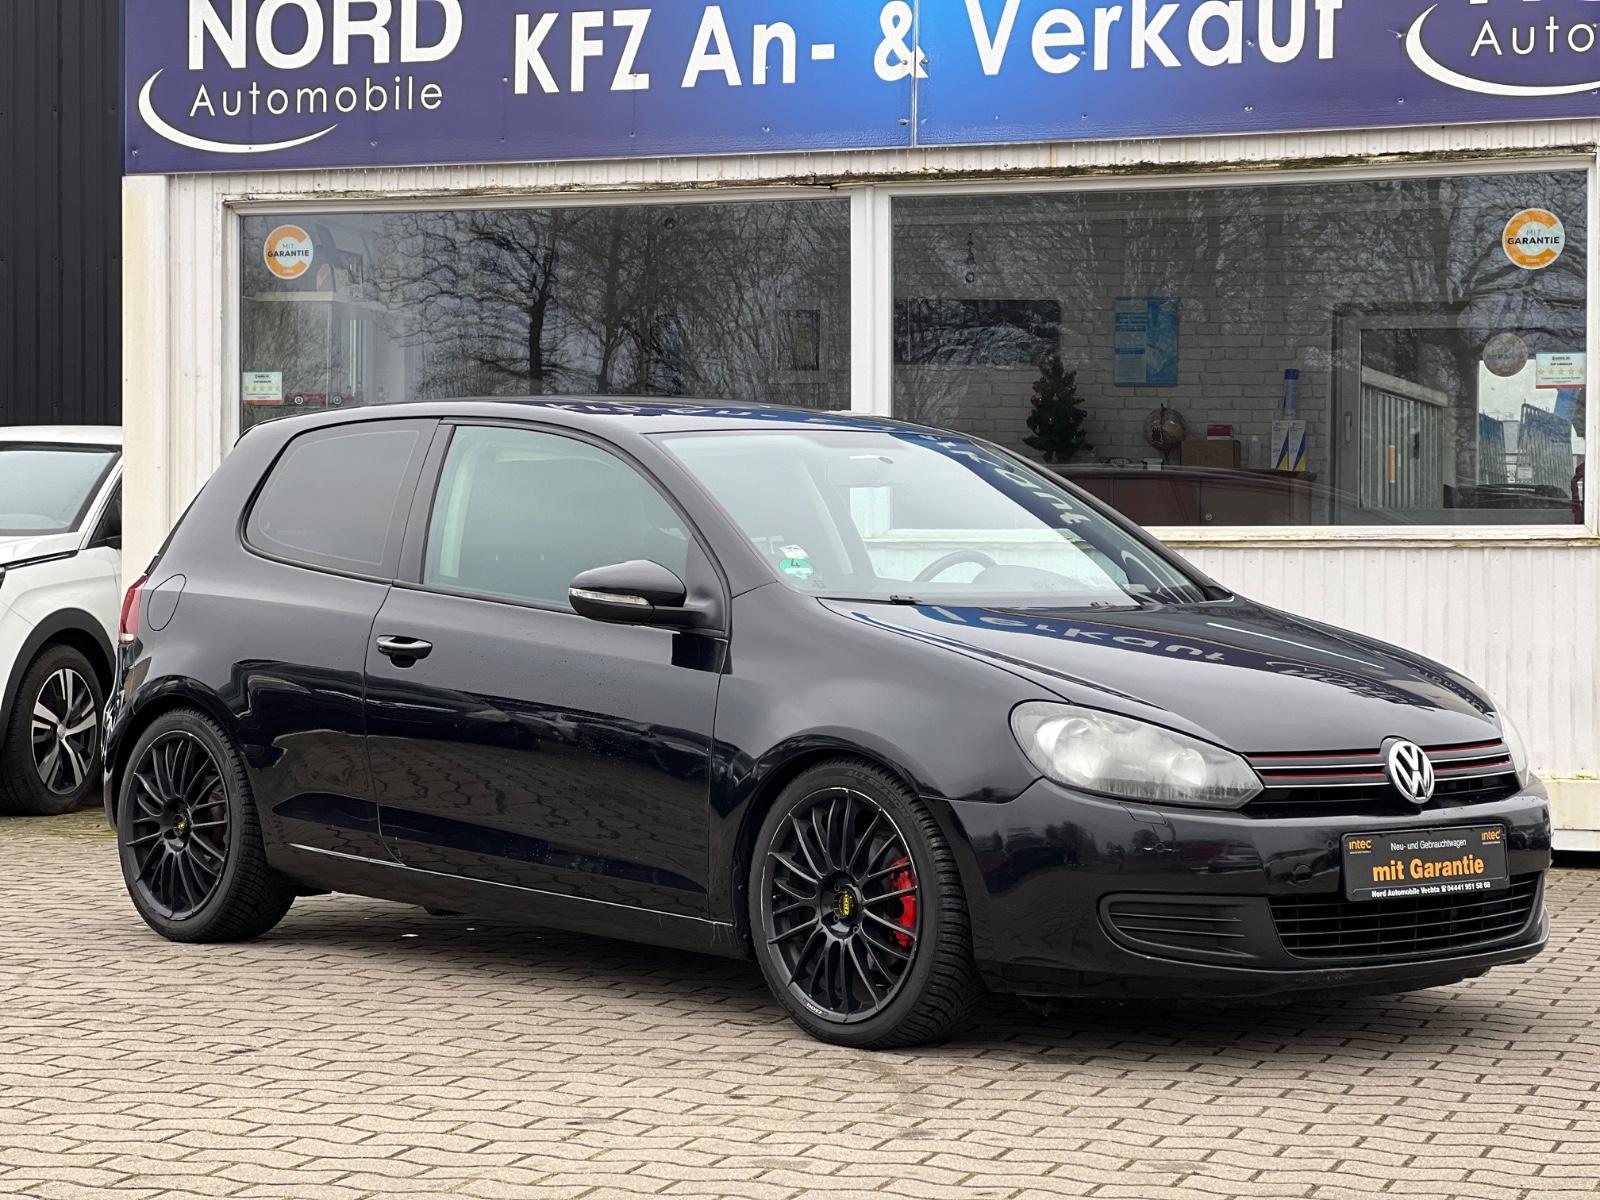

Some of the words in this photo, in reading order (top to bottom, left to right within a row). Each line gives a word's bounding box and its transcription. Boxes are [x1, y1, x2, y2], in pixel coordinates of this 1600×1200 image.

[188, 0, 463, 70] NORD
[514, 8, 652, 95] KFZ
[681, 5, 835, 88] An-
[873, 0, 928, 82] &
[965, 0, 1343, 76] Verkauf
[189, 76, 443, 118] Automobile
[1526, 229, 1542, 237] MIT
[1507, 237, 1560, 245] GARANTIE
[267, 249, 310, 257] GARANTIE
[1481, 830, 1501, 840] intec
[1348, 839, 1373, 850] intec
[1390, 842, 1406, 851] Neu-
[1407, 841, 1419, 850] und
[1420, 839, 1467, 849] Gebrauchtwagen
[1372, 859, 1405, 882] mit
[1409, 854, 1485, 880] Garantie
[1371, 889, 1387, 898] Nord
[1387, 887, 1420, 897] Automobile
[1446, 884, 1464, 892] 04441
[1464, 882, 1475, 890] 951
